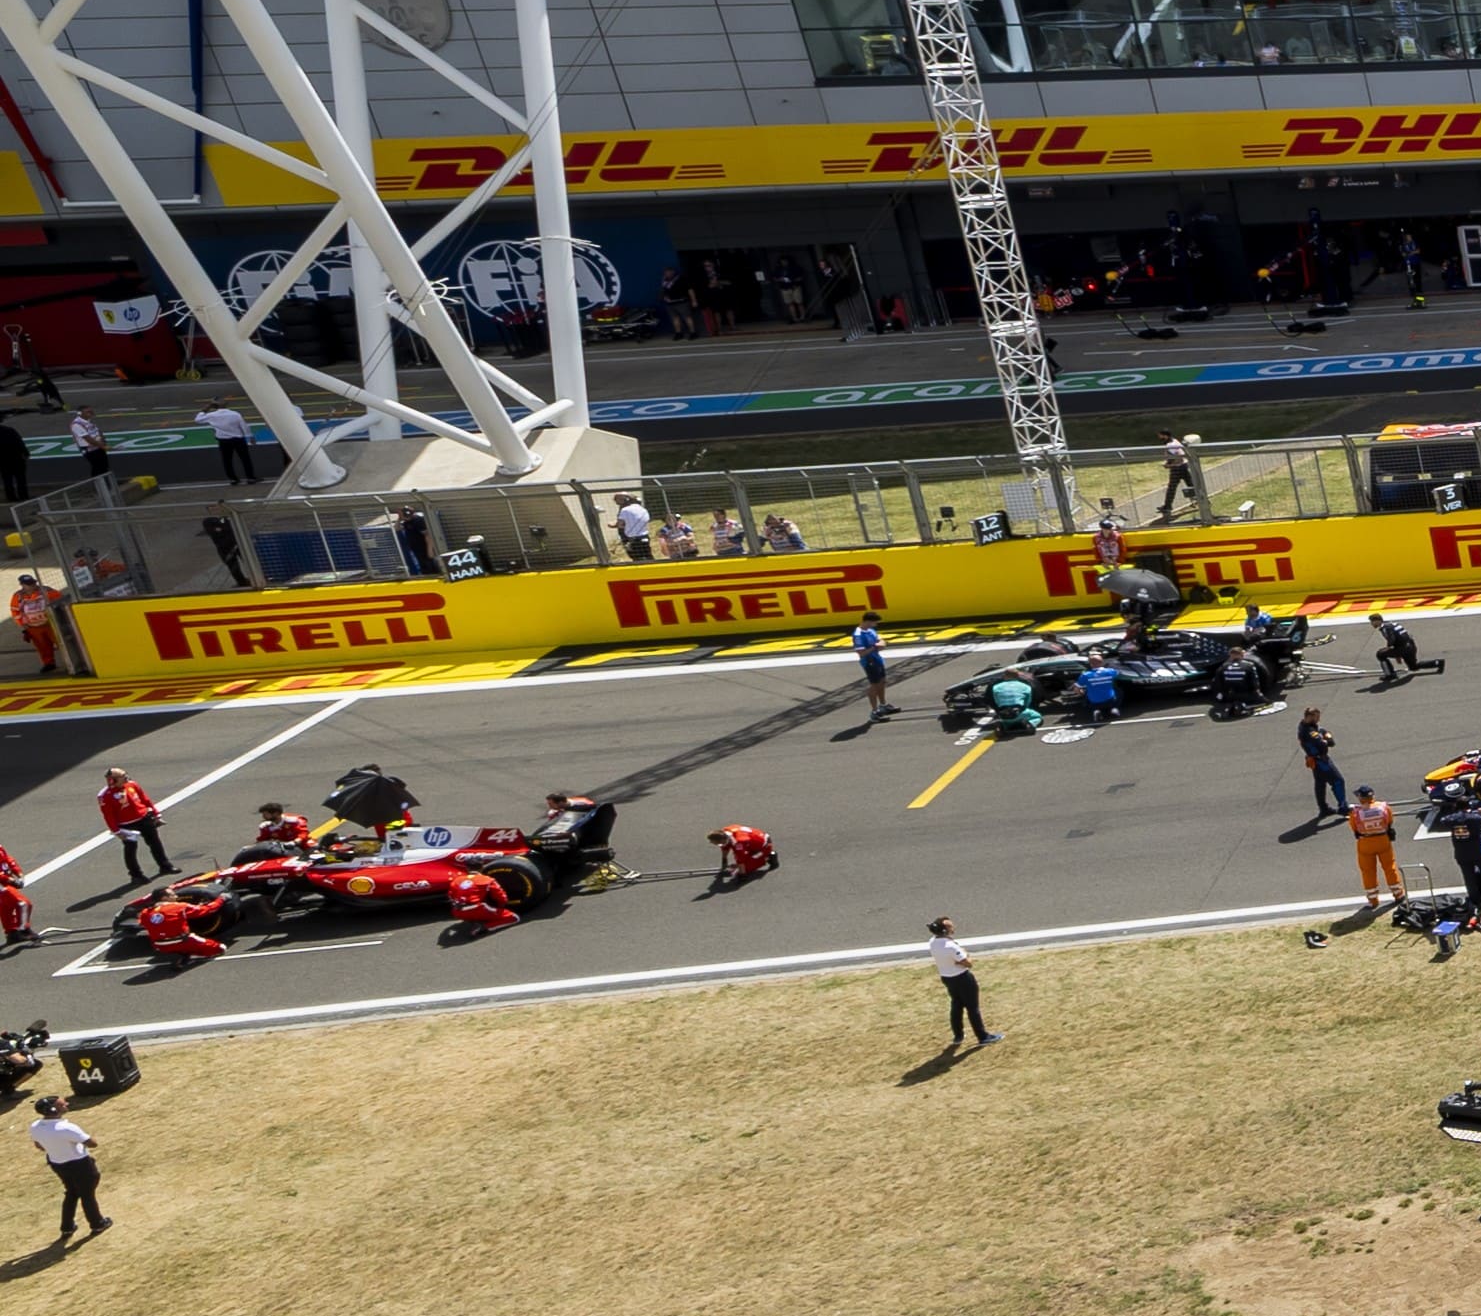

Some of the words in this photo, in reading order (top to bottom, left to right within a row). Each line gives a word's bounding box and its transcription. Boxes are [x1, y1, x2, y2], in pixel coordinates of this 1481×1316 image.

[1445, 488, 1455, 500] 3
[1443, 500, 1462, 512] VER
[979, 516, 1000, 531] 12
[982, 530, 1004, 543] ANT
[448, 551, 477, 566] 44
[450, 566, 483, 580] HAM
[608, 563, 886, 627] PIRELLI
[145, 592, 453, 661] PIRELLI
[426, 827, 449, 847] hp
[488, 829, 519, 843] 44
[394, 880, 431, 890] CEVA
[77, 1069, 104, 1083] 44
